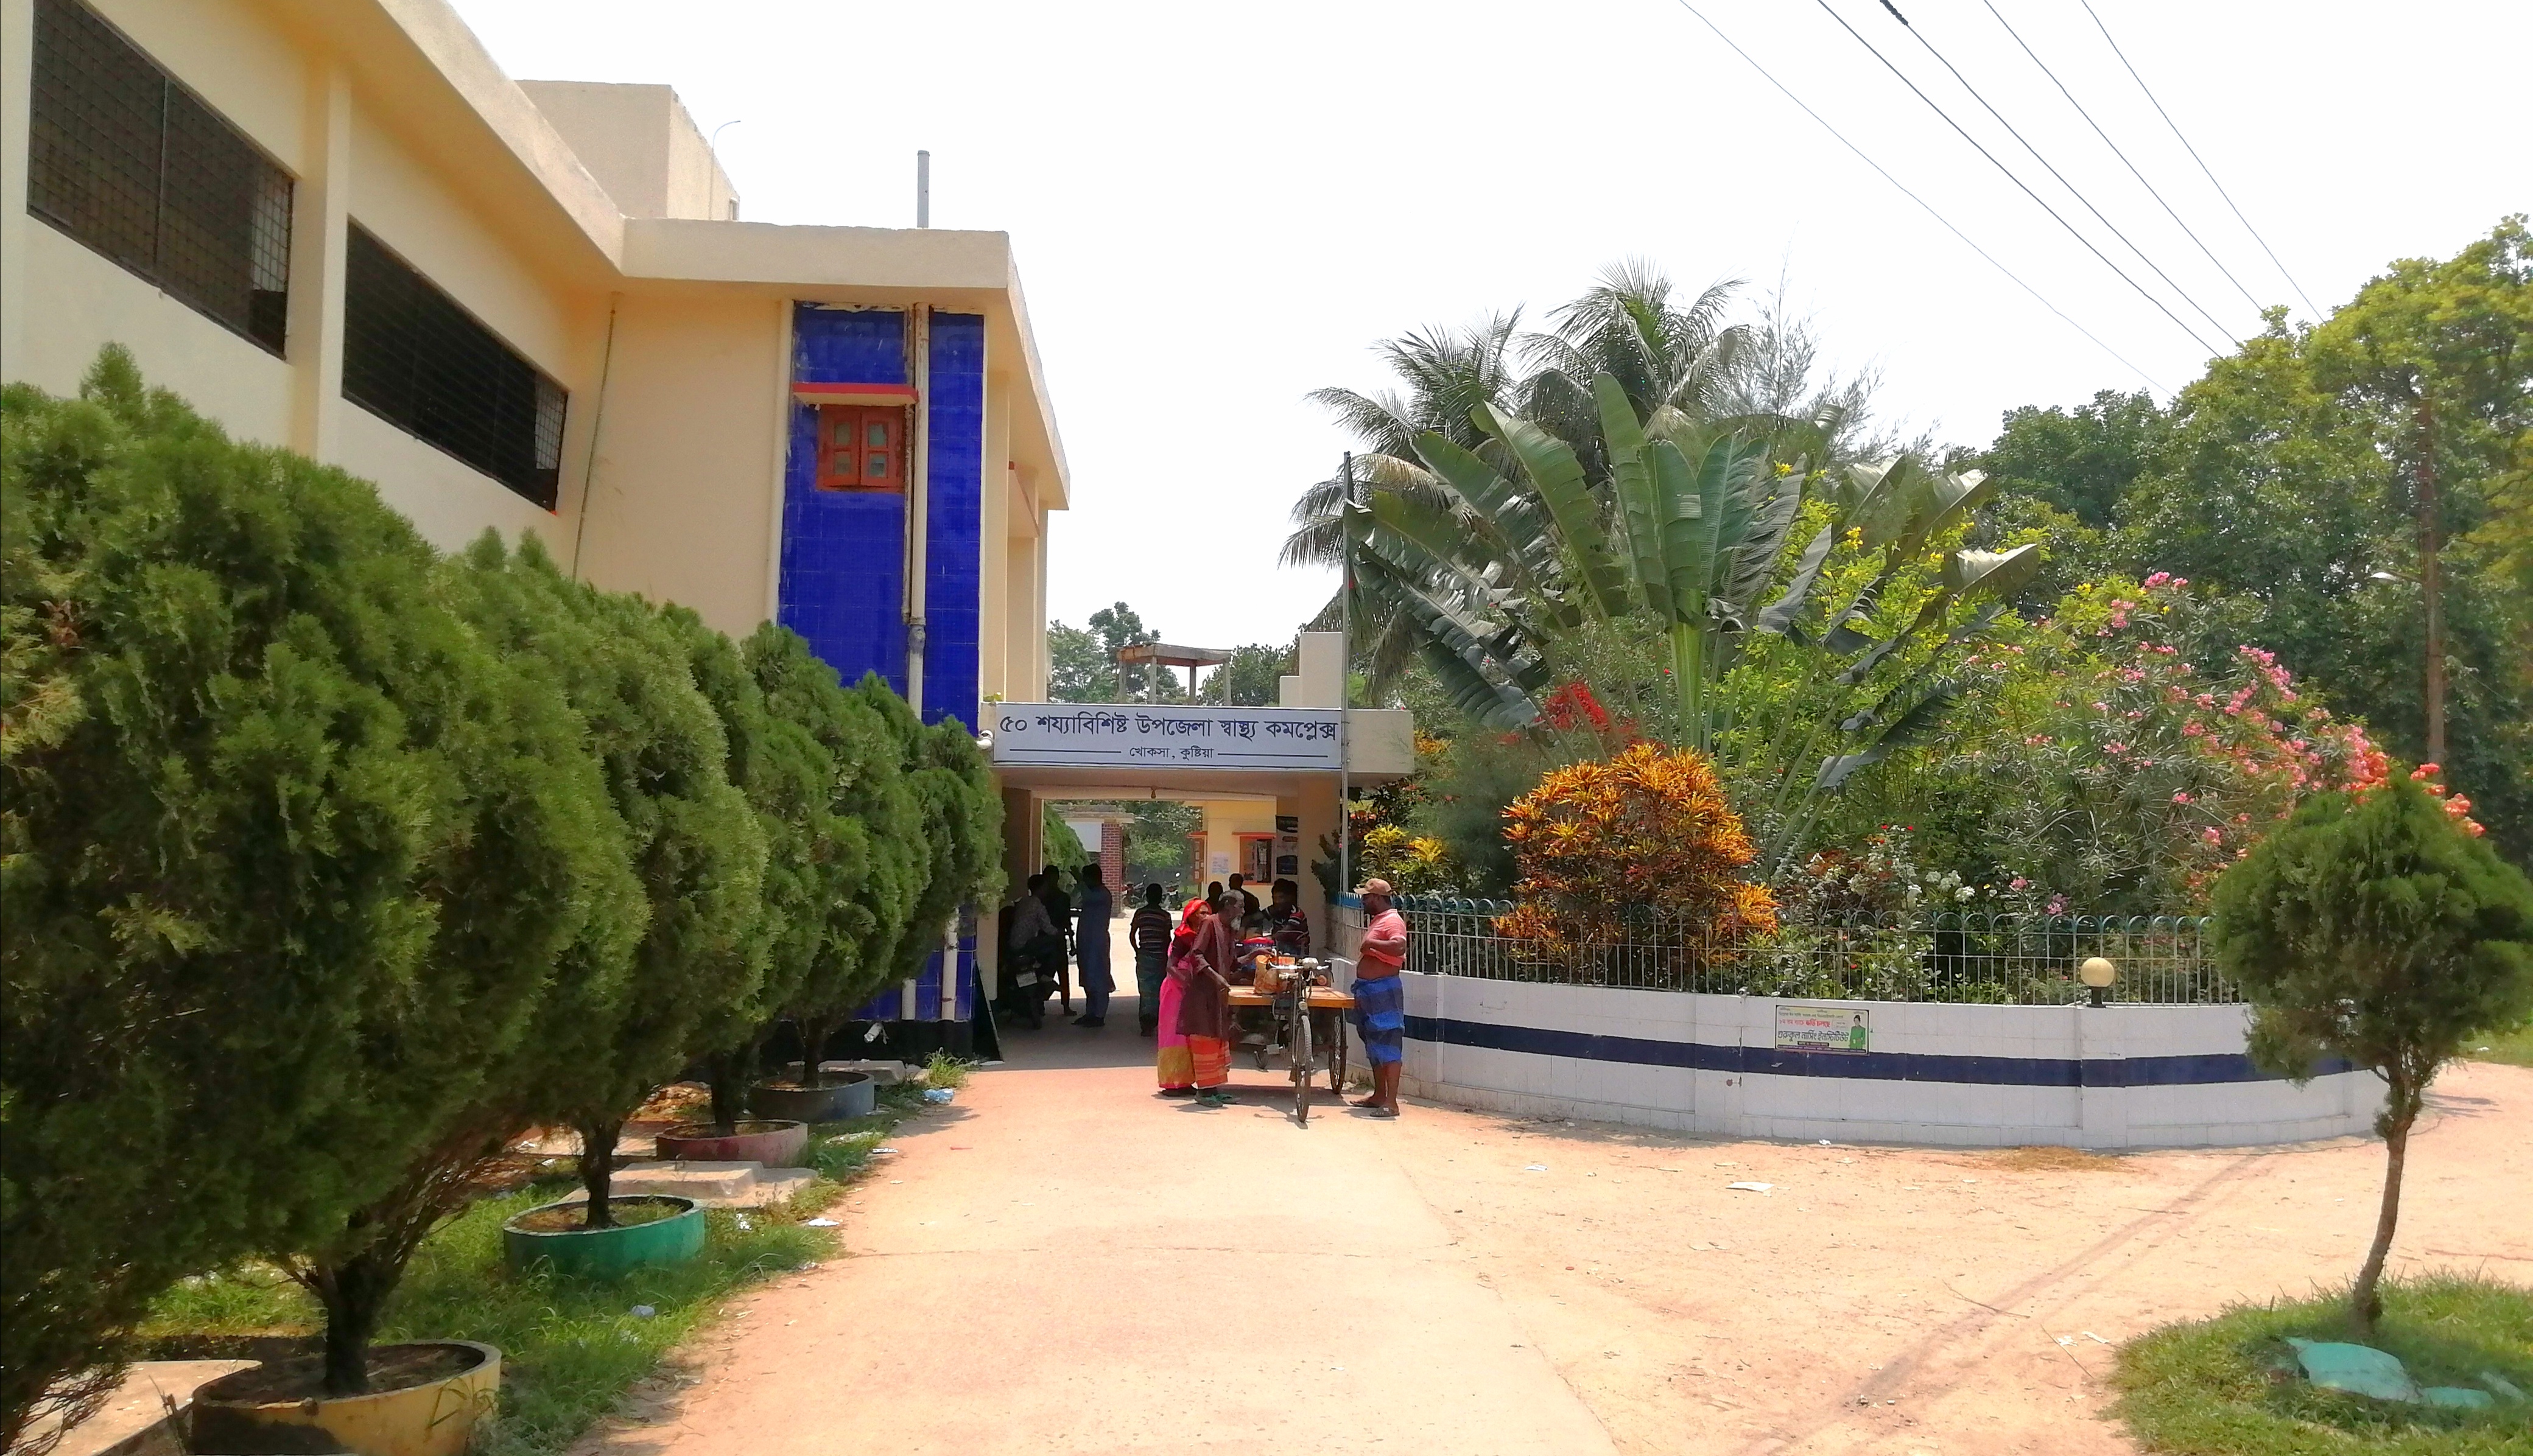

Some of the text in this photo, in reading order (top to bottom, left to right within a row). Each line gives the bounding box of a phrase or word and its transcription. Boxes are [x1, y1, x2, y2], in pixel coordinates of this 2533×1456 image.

[1000, 711, 1338, 741] ৫০ শয্যাবিশিষ্ট উপজেলা স্বাস্থ্য কমপ্লেক্স
[1179, 745, 1214, 760] কুষ্টিয়া
[1778, 1029, 1849, 1041] গুরুকুল নার্সিং ইনস্টিটিউট
